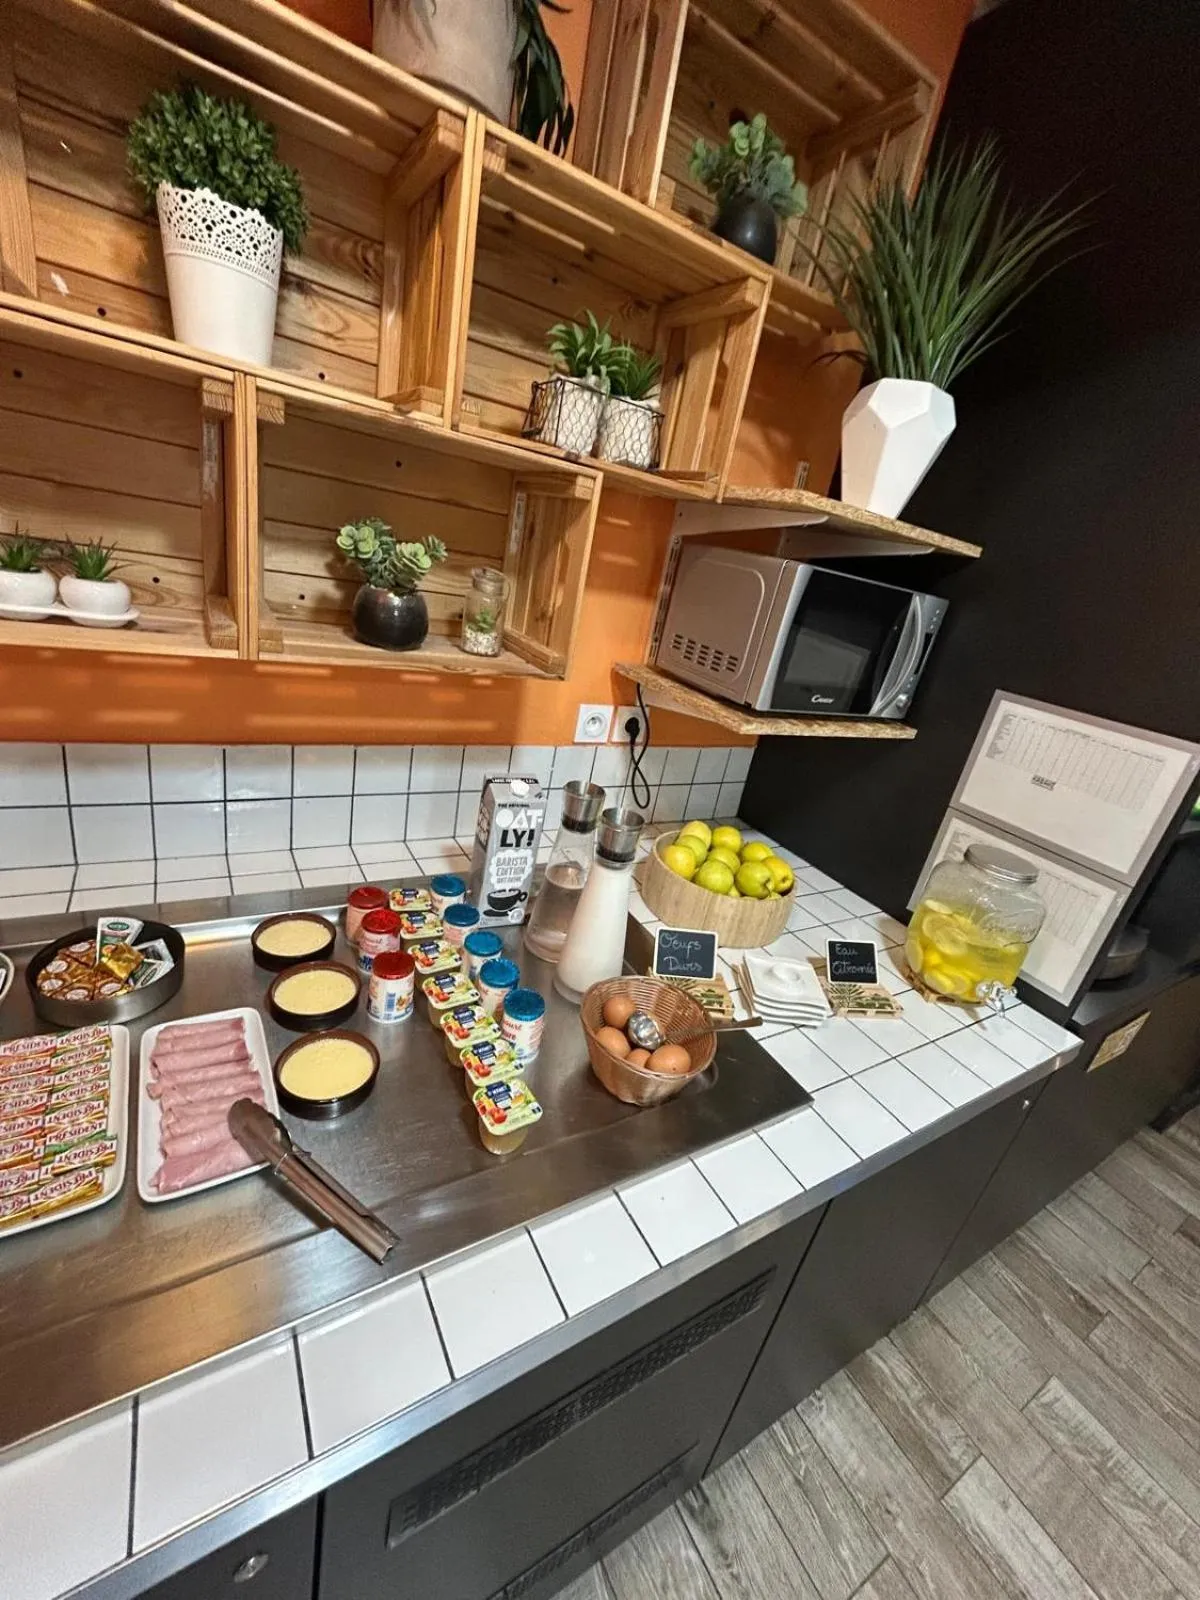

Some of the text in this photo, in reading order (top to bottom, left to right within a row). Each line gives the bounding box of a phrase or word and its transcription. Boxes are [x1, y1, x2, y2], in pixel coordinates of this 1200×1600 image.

[500, 829, 535, 848] LY!
[496, 857, 528, 867] BARISTA
[835, 944, 858, 955] Eau
